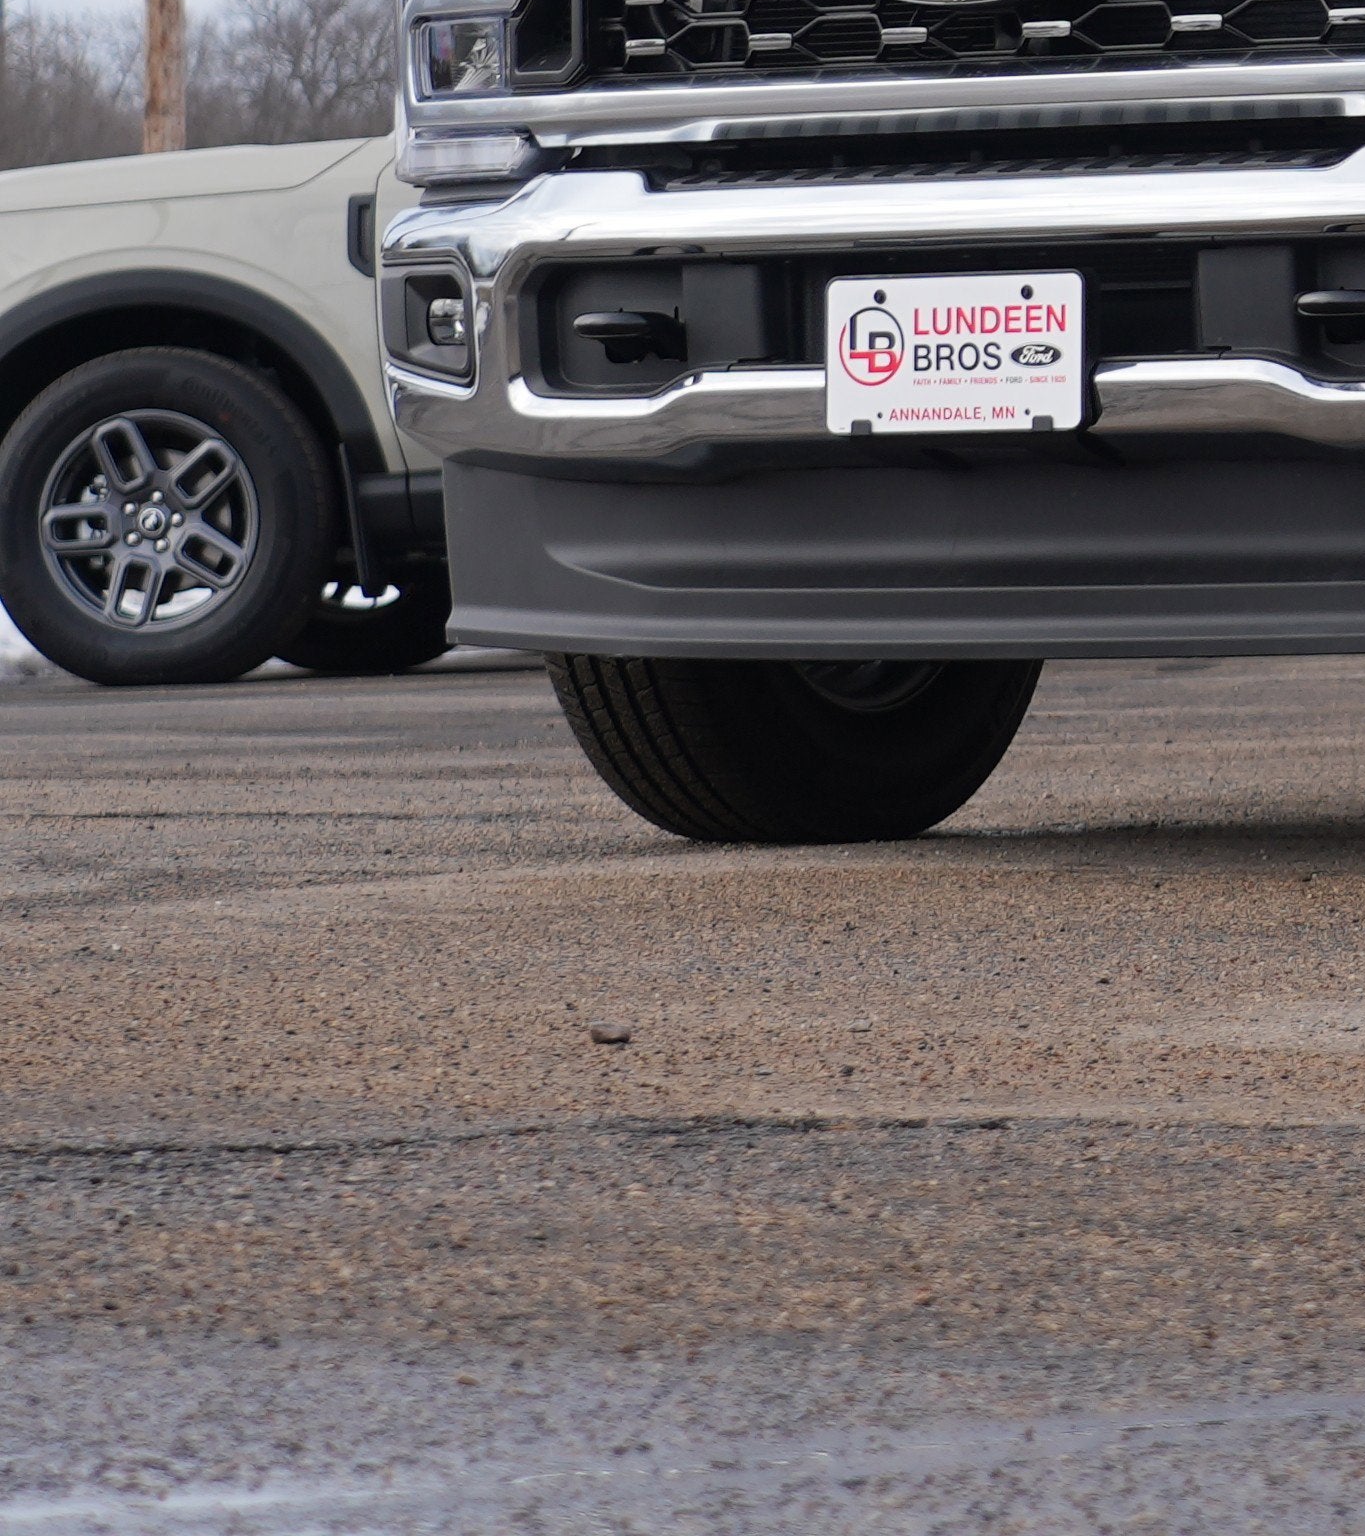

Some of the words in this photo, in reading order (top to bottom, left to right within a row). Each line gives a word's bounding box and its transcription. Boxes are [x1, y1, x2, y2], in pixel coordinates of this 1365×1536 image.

[913, 304, 1067, 336] LUNDEEN
[913, 341, 1002, 372] BROS
[939, 377, 963, 386] FAMILY
[970, 376, 998, 385] FRIENDS
[1005, 376, 1023, 384] FORD
[889, 407, 987, 422] ANNANDALE,
[992, 406, 1016, 420] MN
